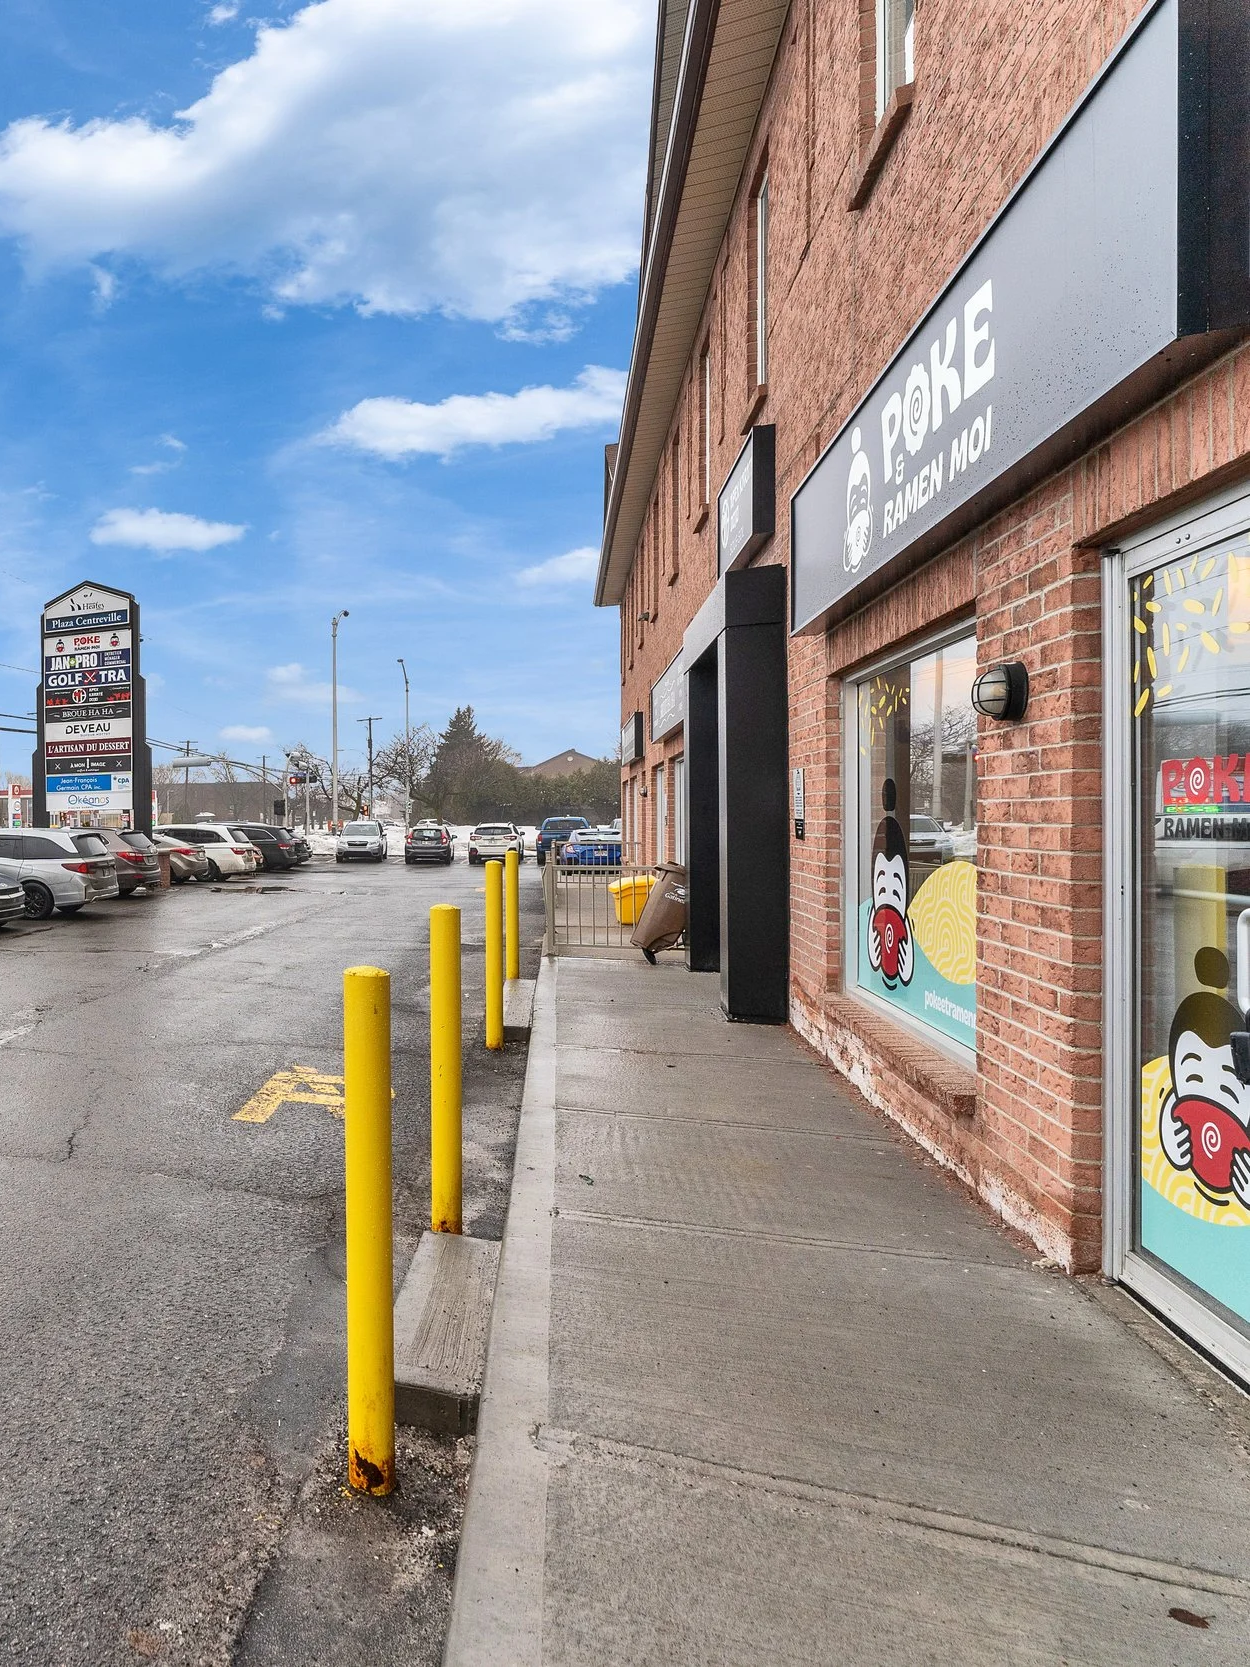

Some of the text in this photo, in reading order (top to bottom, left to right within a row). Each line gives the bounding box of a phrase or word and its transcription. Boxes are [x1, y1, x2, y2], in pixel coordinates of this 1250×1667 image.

[881, 278, 995, 484] POKE
[882, 404, 993, 539] & RAMEN MOI
[51, 612, 122, 629] Plaza Centreville
[73, 635, 101, 646] POKE
[50, 653, 98, 671] JAN PRO
[48, 672, 83, 687] GOLF
[62, 710, 87, 718] BROUE
[65, 722, 111, 735] DEVEAU
[48, 741, 130, 754] L'ARTISAN DU DESSERT
[1161, 752, 1250, 805] POK
[68, 794, 110, 805] Okéanos
[1164, 817, 1225, 839] RAMEN
